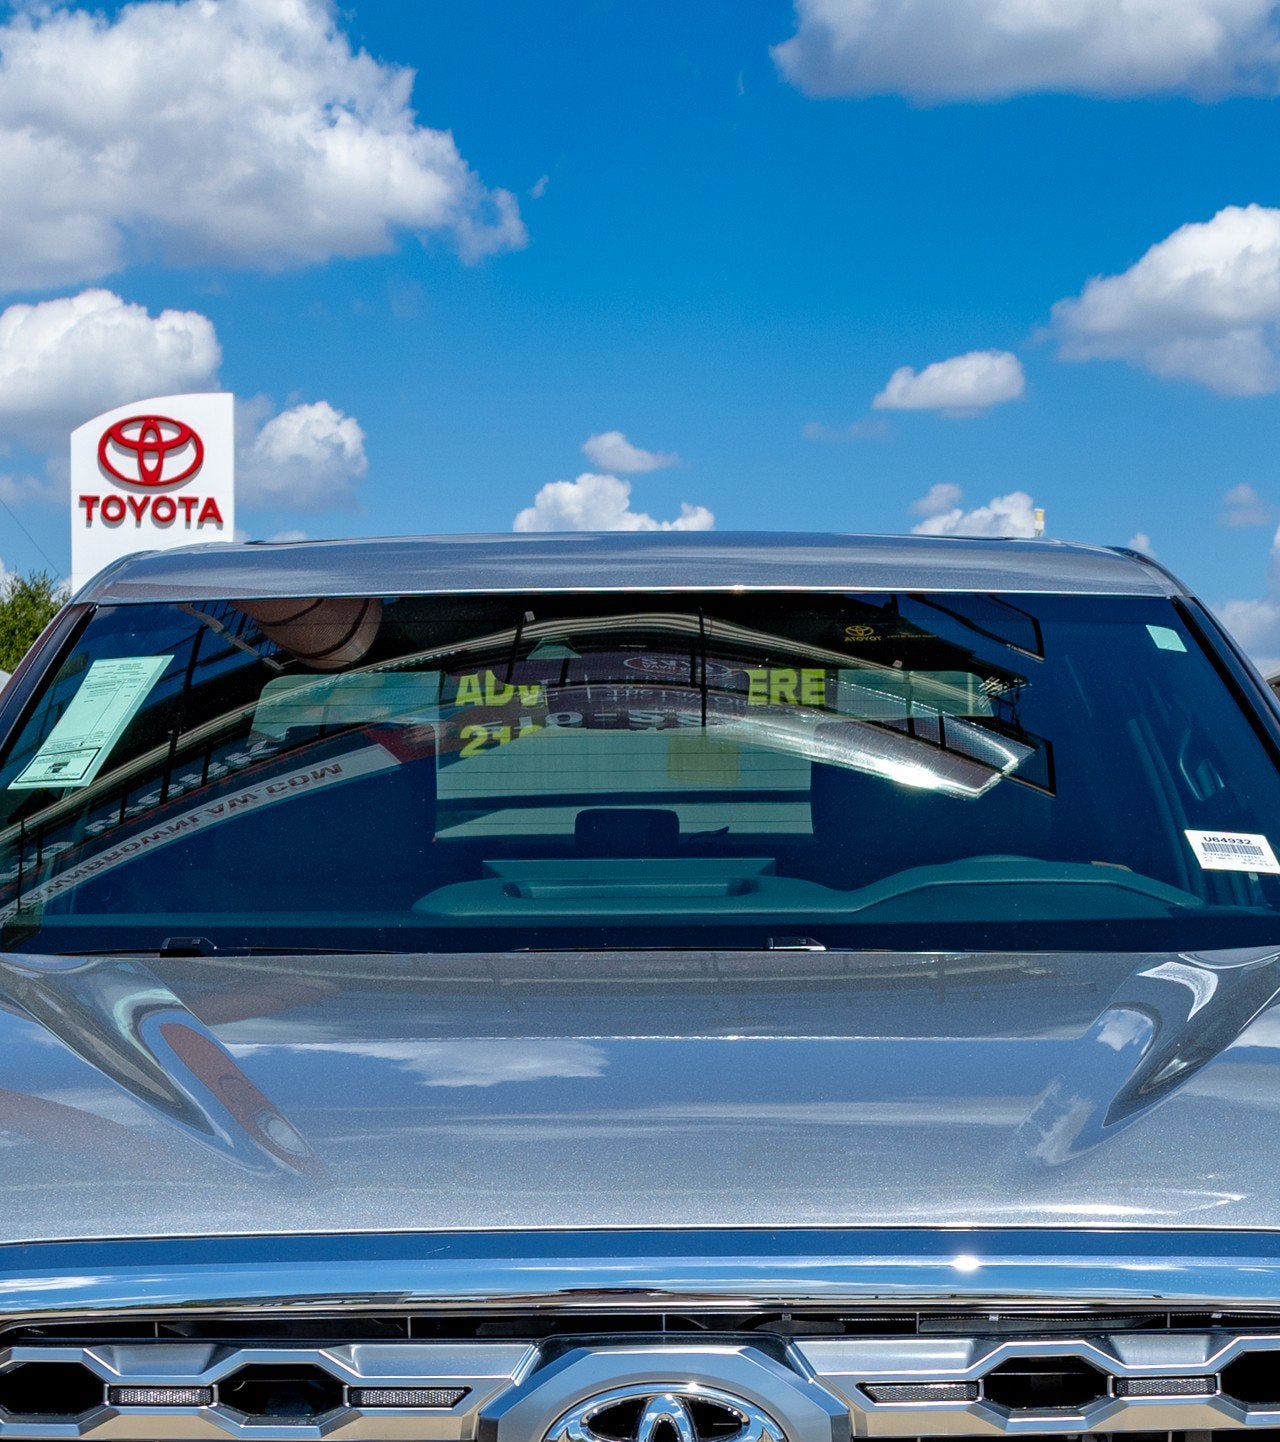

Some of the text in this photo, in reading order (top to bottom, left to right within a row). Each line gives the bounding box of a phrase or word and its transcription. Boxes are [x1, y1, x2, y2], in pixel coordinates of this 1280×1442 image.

[79, 495, 223, 523] TOYOTA
[748, 669, 826, 706] ERE
[1203, 836, 1251, 845] U64932
